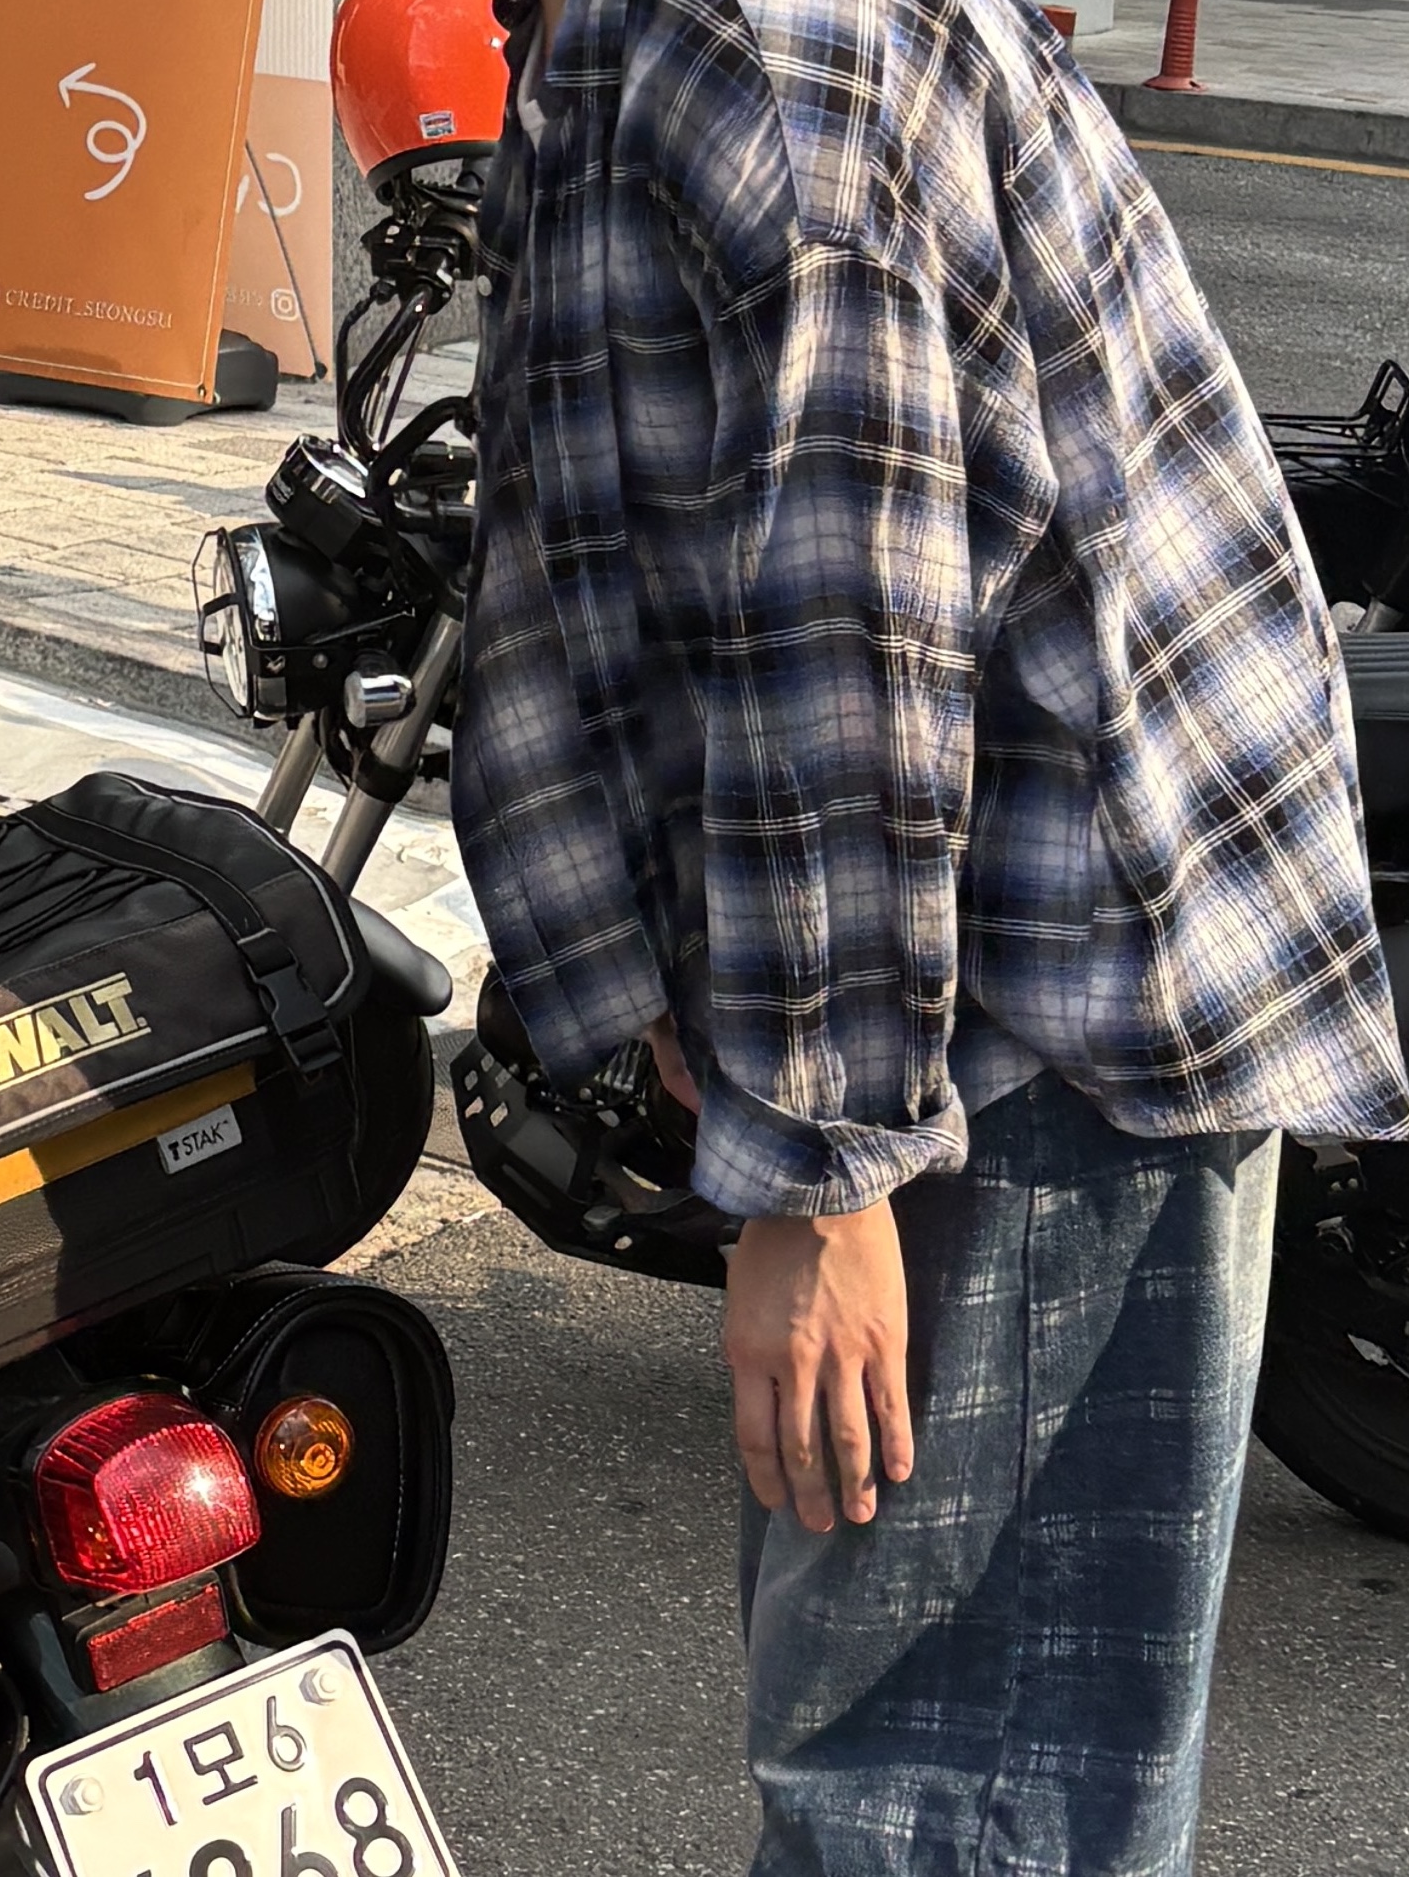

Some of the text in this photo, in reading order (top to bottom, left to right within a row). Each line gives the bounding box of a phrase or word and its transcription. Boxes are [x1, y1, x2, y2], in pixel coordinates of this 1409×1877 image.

[5, 289, 173, 328] CREDIT_SEONGSU
[133, 1695, 307, 1827] 1모6
[136, 1777, 415, 1877] 68
